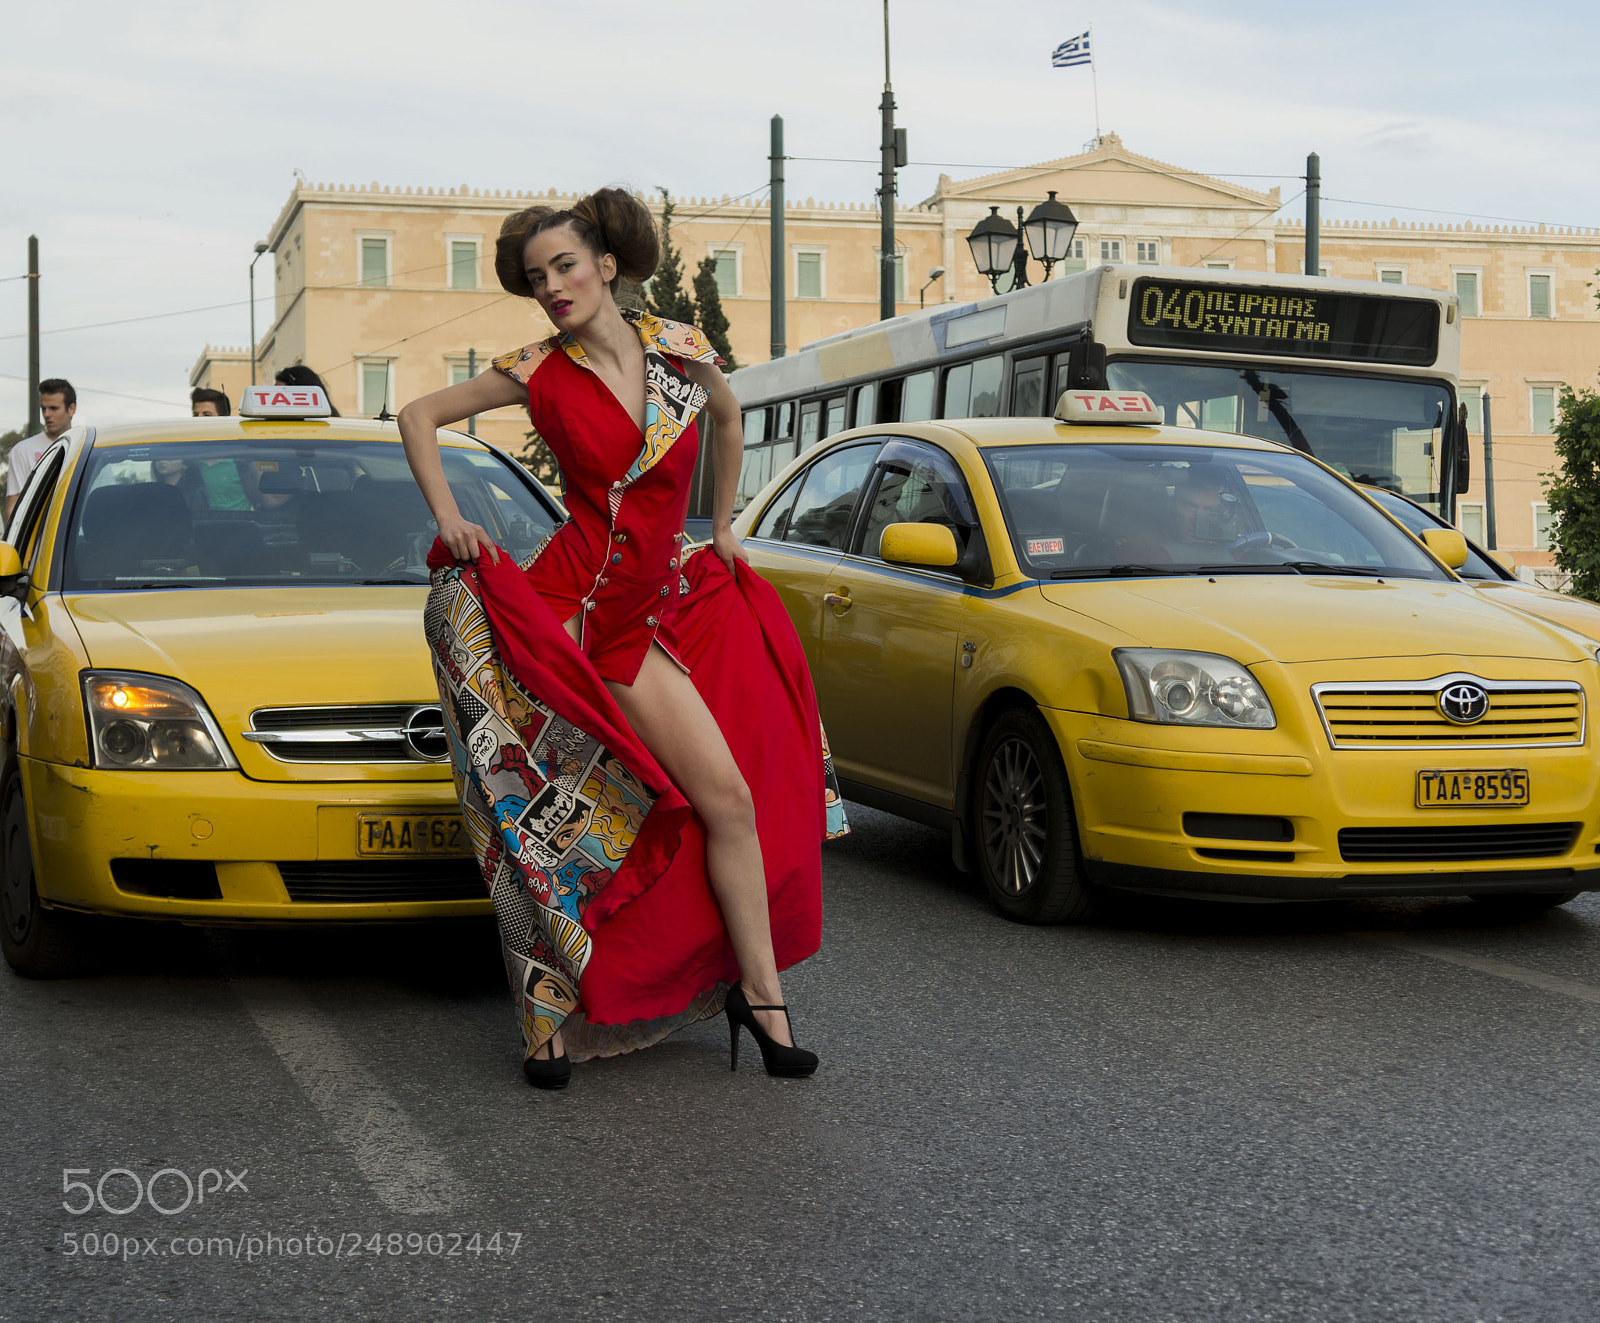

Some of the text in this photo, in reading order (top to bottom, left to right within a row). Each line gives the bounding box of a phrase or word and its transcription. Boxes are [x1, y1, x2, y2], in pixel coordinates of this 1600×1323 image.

[1140, 286, 1317, 328] 040 ΠΕΙΡΑΙΑΣ
[1203, 314, 1330, 341] ΣΥΝΤΑΓΜΑ
[254, 392, 318, 406] ΤΑΞΙ
[1074, 395, 1152, 412] ΤΑΞΙ
